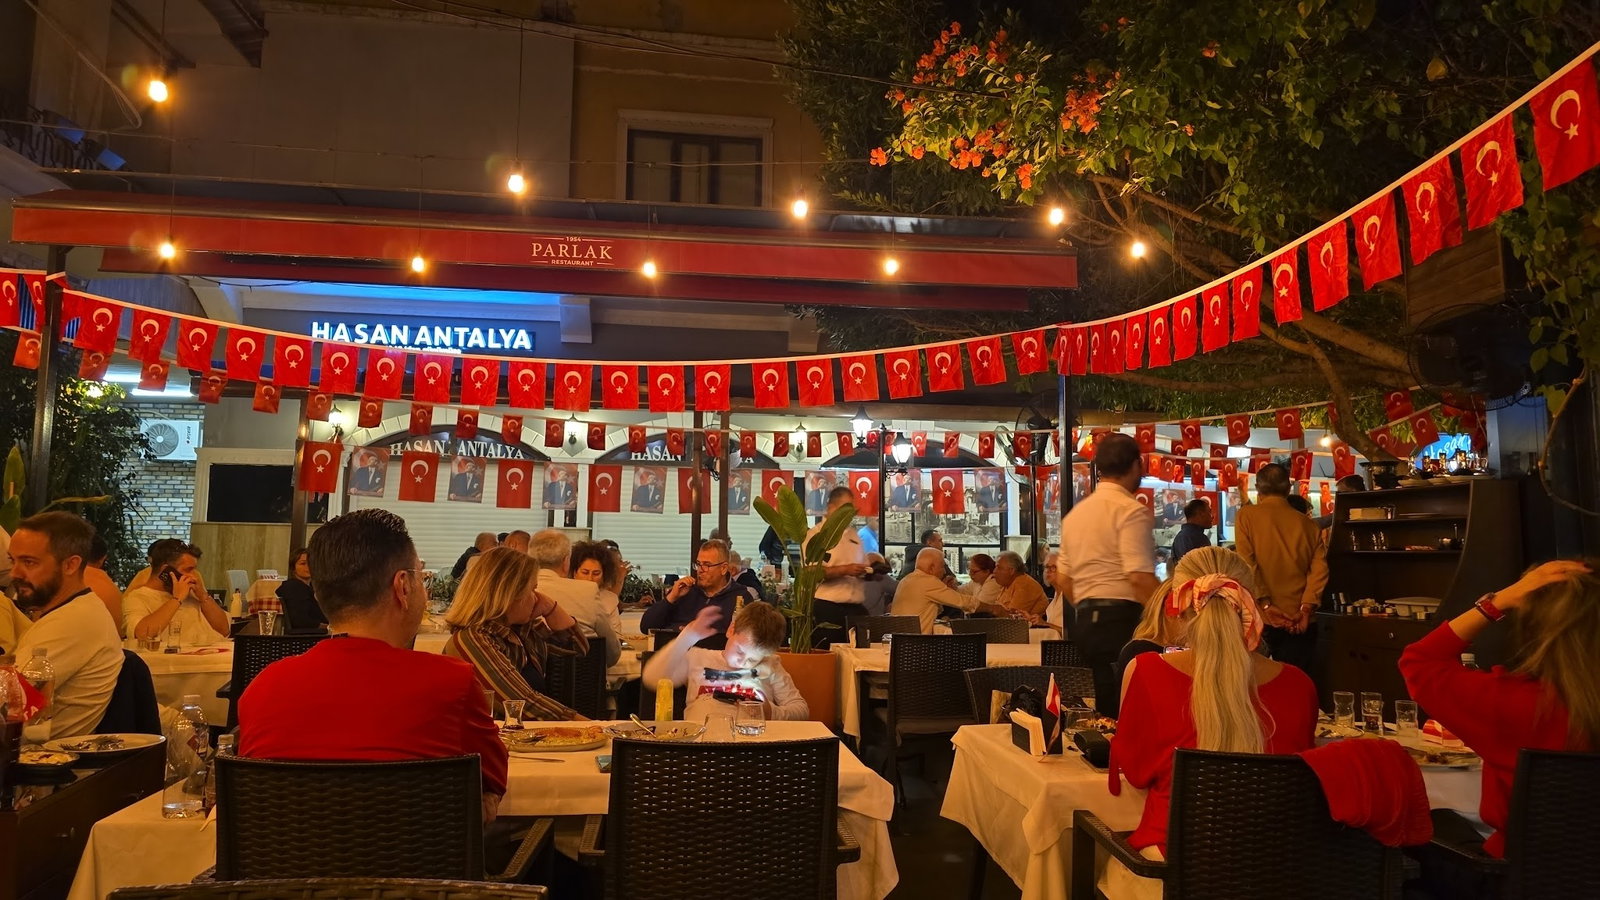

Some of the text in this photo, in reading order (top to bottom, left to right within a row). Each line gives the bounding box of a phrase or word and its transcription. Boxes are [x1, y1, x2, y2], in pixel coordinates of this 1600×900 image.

[531, 242, 613, 260] PARLAK
[311, 321, 532, 350] HASAN ANTALYA
[389, 440, 525, 459] HASAN ANTALYA
